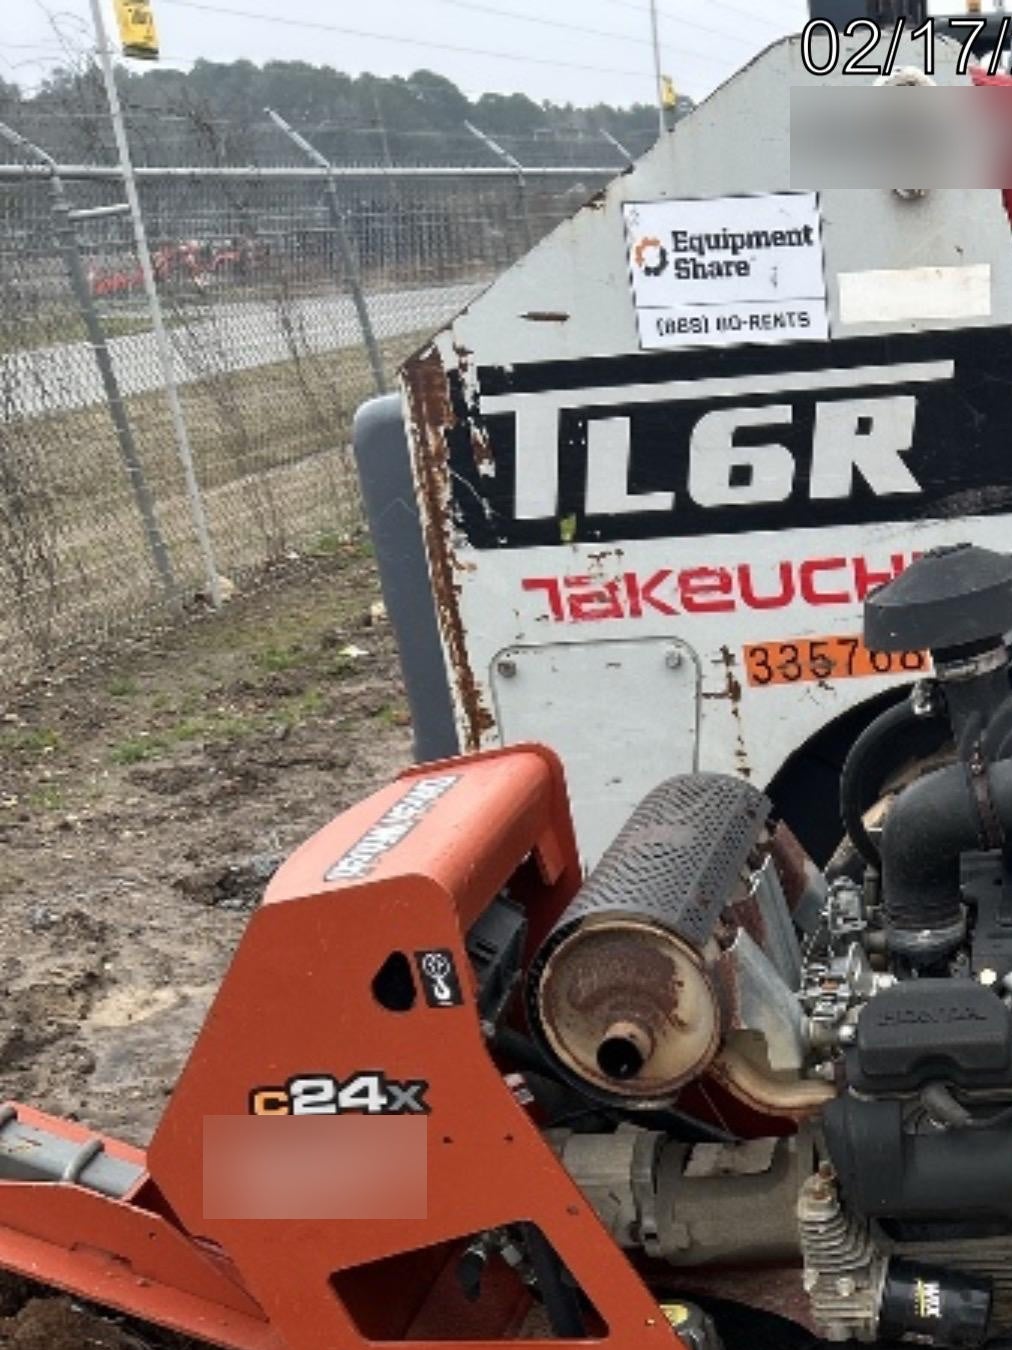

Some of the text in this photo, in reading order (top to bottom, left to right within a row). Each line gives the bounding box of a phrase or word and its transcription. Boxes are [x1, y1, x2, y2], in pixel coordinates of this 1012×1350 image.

[671, 224, 814, 256] Equipment
[674, 258, 750, 279] Share
[480, 359, 954, 520] TL6R
